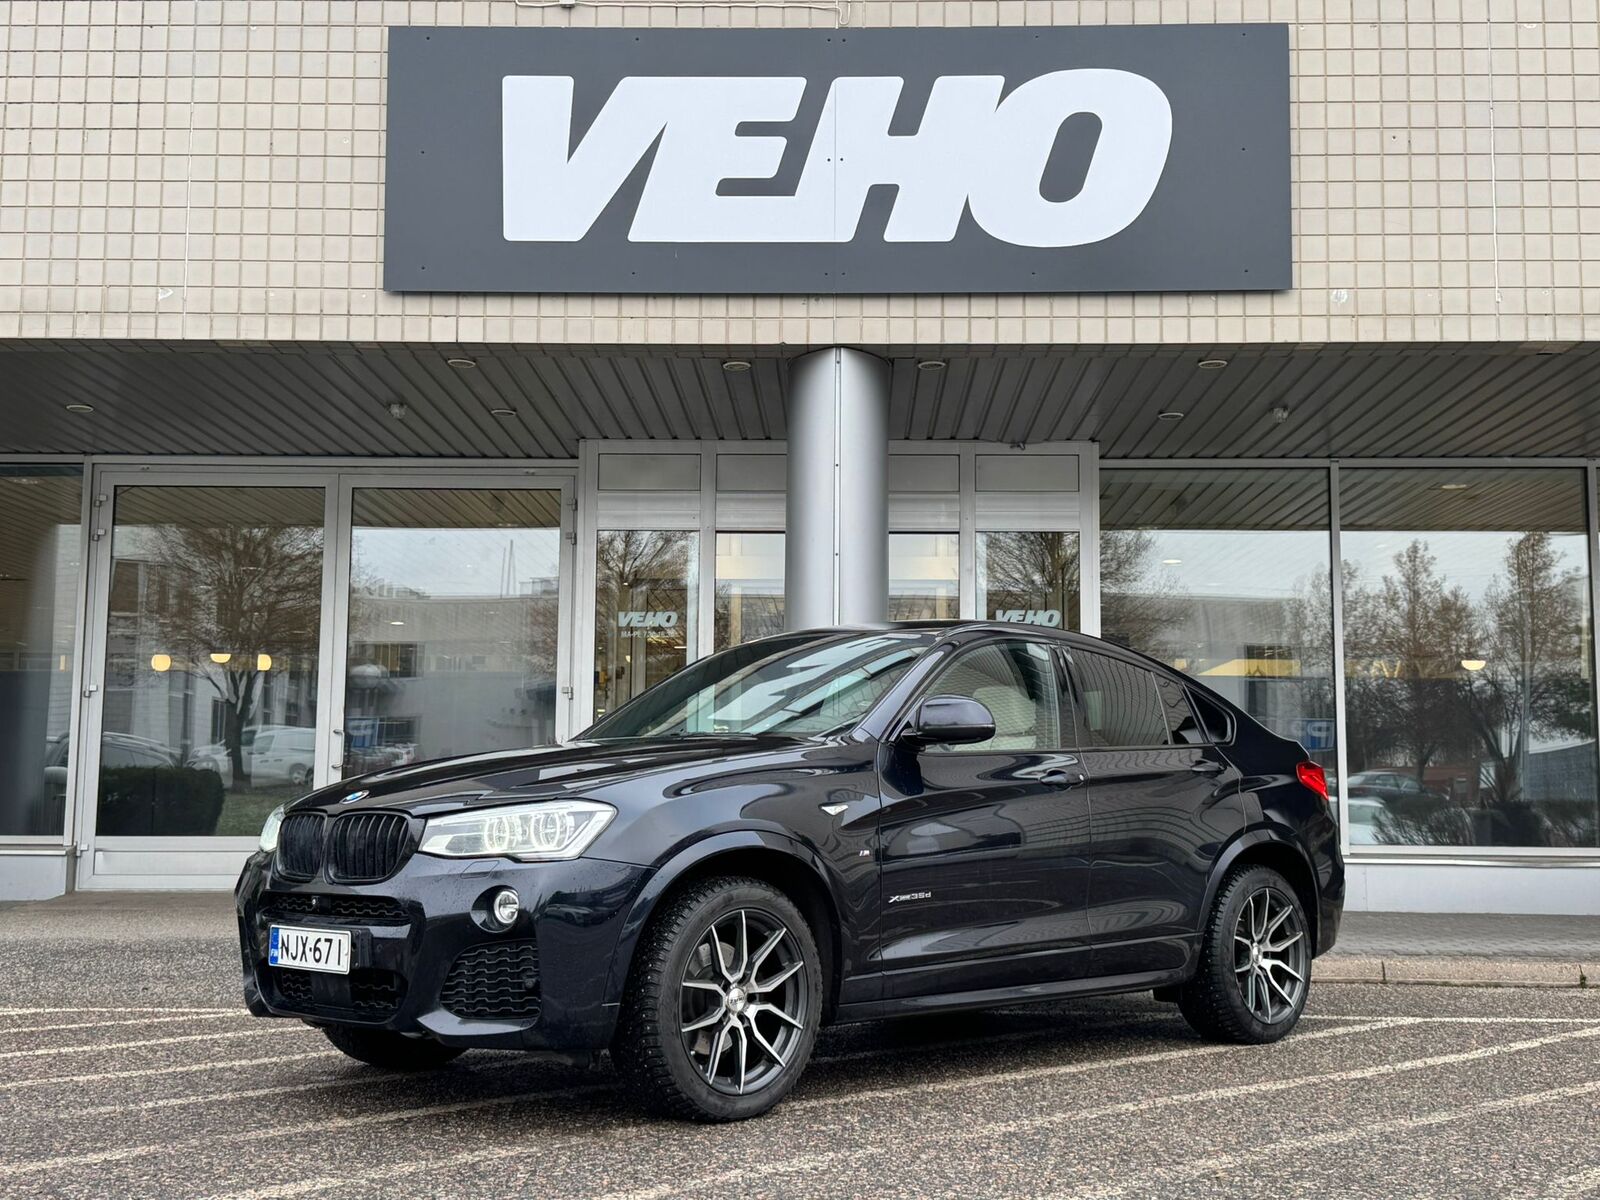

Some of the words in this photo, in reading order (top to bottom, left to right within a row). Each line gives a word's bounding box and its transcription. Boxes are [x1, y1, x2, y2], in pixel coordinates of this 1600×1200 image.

[502, 68, 1173, 248] VEHO
[618, 611, 678, 627] VEHO
[996, 609, 1060, 627] VEHO
[280, 933, 342, 966] NJX-671
